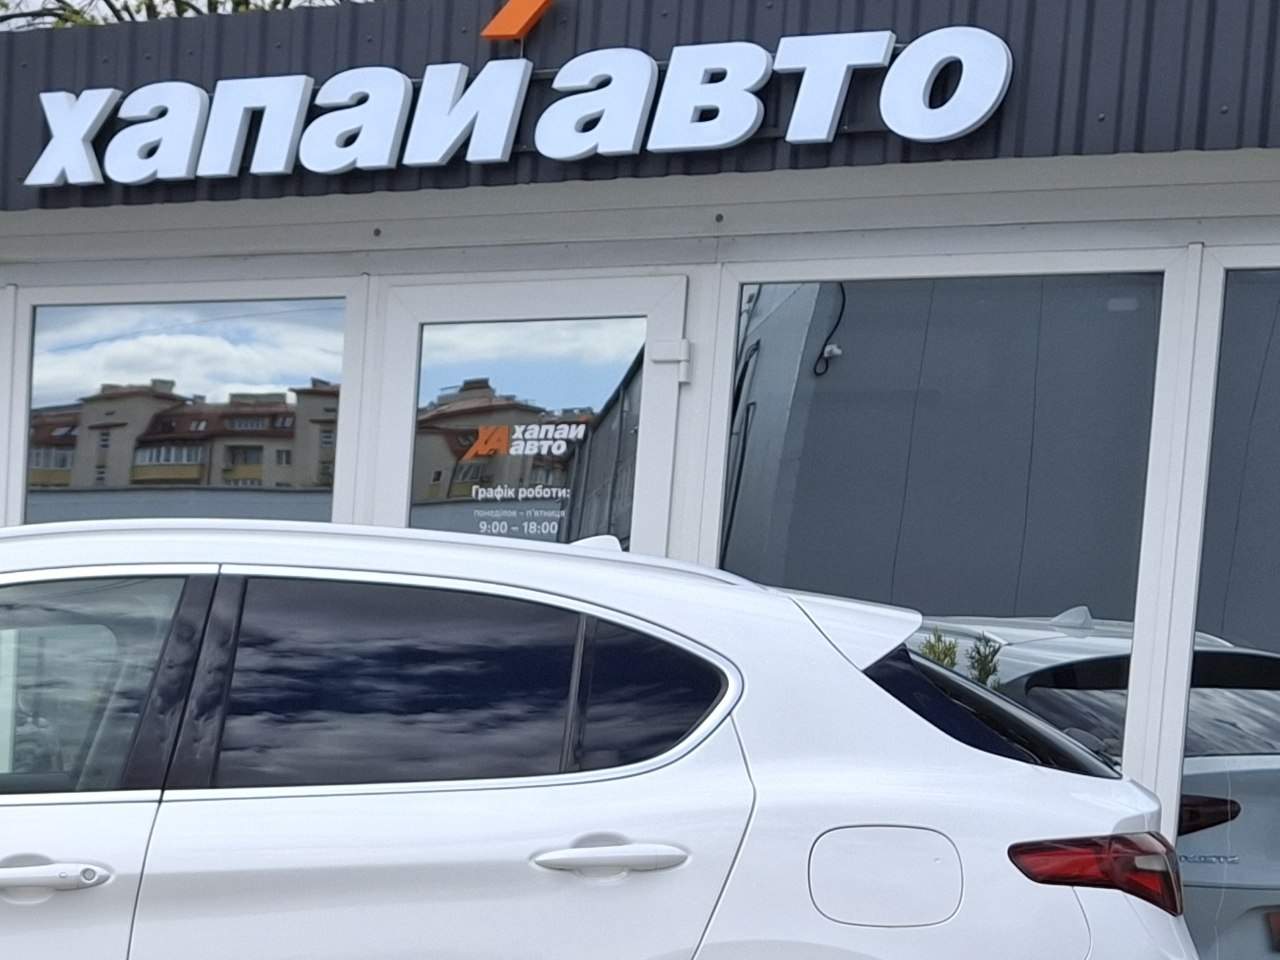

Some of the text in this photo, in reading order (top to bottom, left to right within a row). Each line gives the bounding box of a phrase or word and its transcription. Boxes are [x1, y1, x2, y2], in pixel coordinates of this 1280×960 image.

[533, 25, 1014, 162] авто
[509, 440, 567, 455] авто
[472, 485, 571, 501] Графік роботи:
[479, 521, 508, 533] 9:00
[522, 521, 559, 534] 18:00
